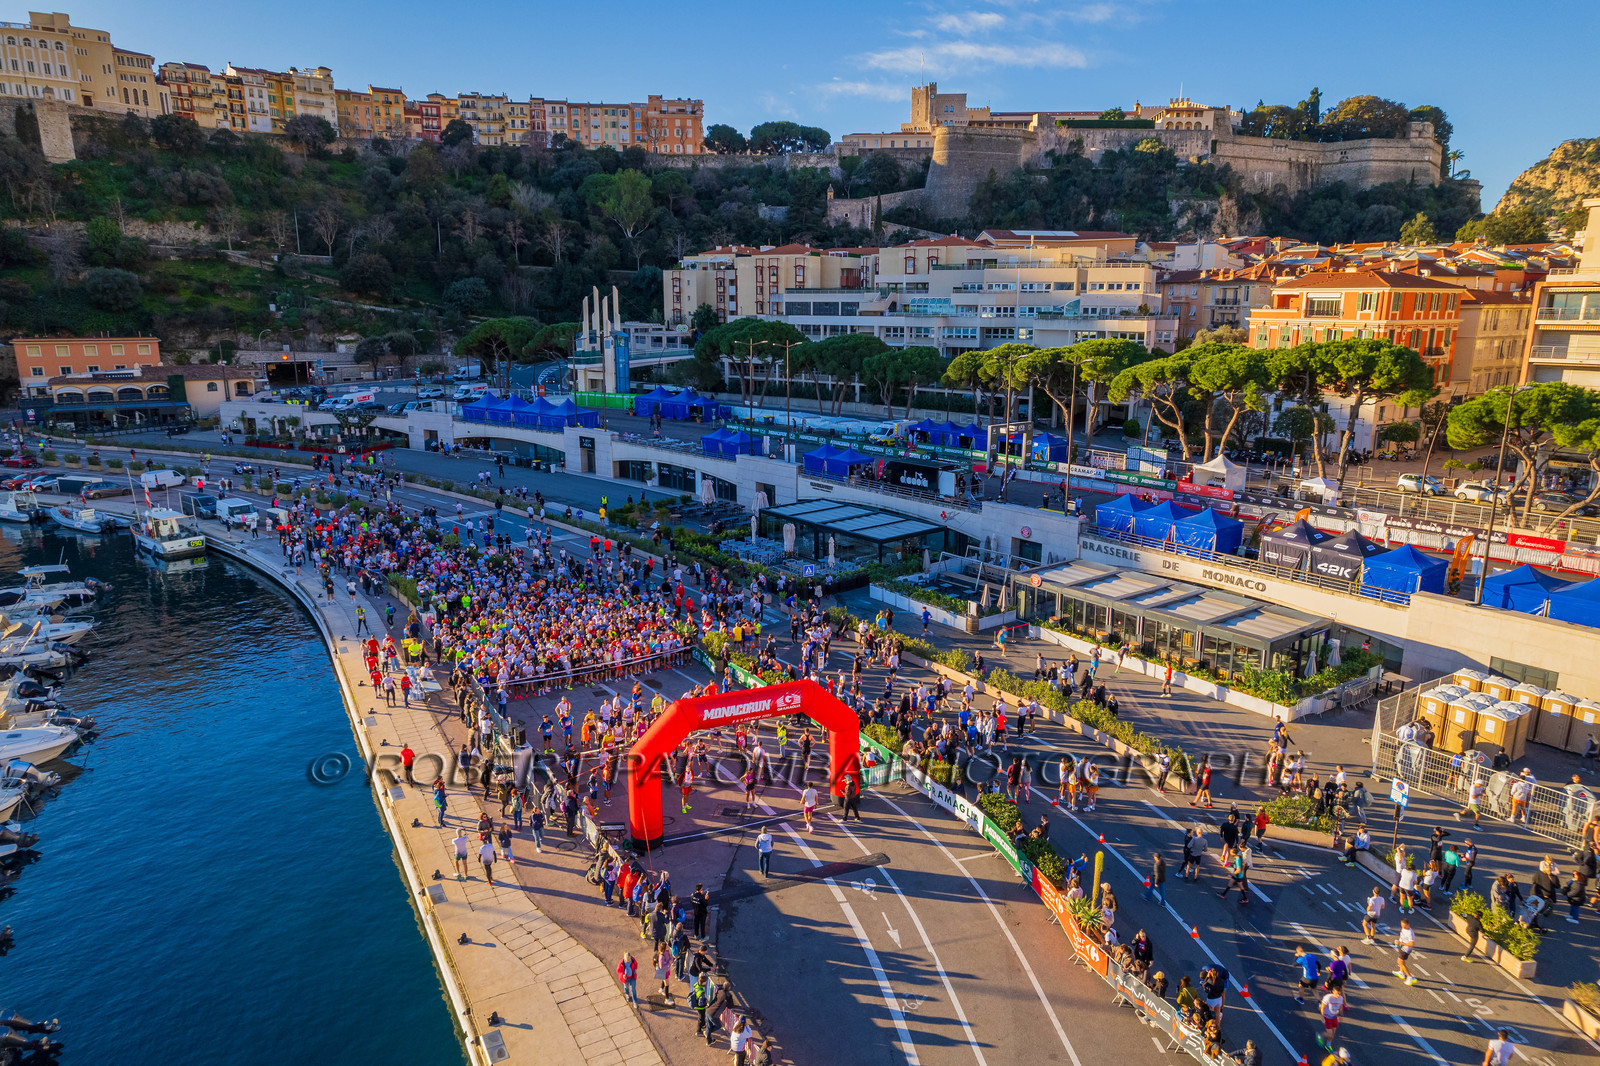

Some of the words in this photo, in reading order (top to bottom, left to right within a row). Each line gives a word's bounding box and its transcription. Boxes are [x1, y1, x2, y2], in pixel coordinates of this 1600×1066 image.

[1082, 540, 1141, 563] BRASSERIE
[1162, 559, 1180, 572] DE
[1202, 569, 1267, 592] MONACO
[1317, 562, 1352, 579] 42K
[702, 699, 772, 721] MONACORUN
[925, 782, 979, 824] GRAMAGLIA
[1115, 975, 1171, 1022] RUNNING
